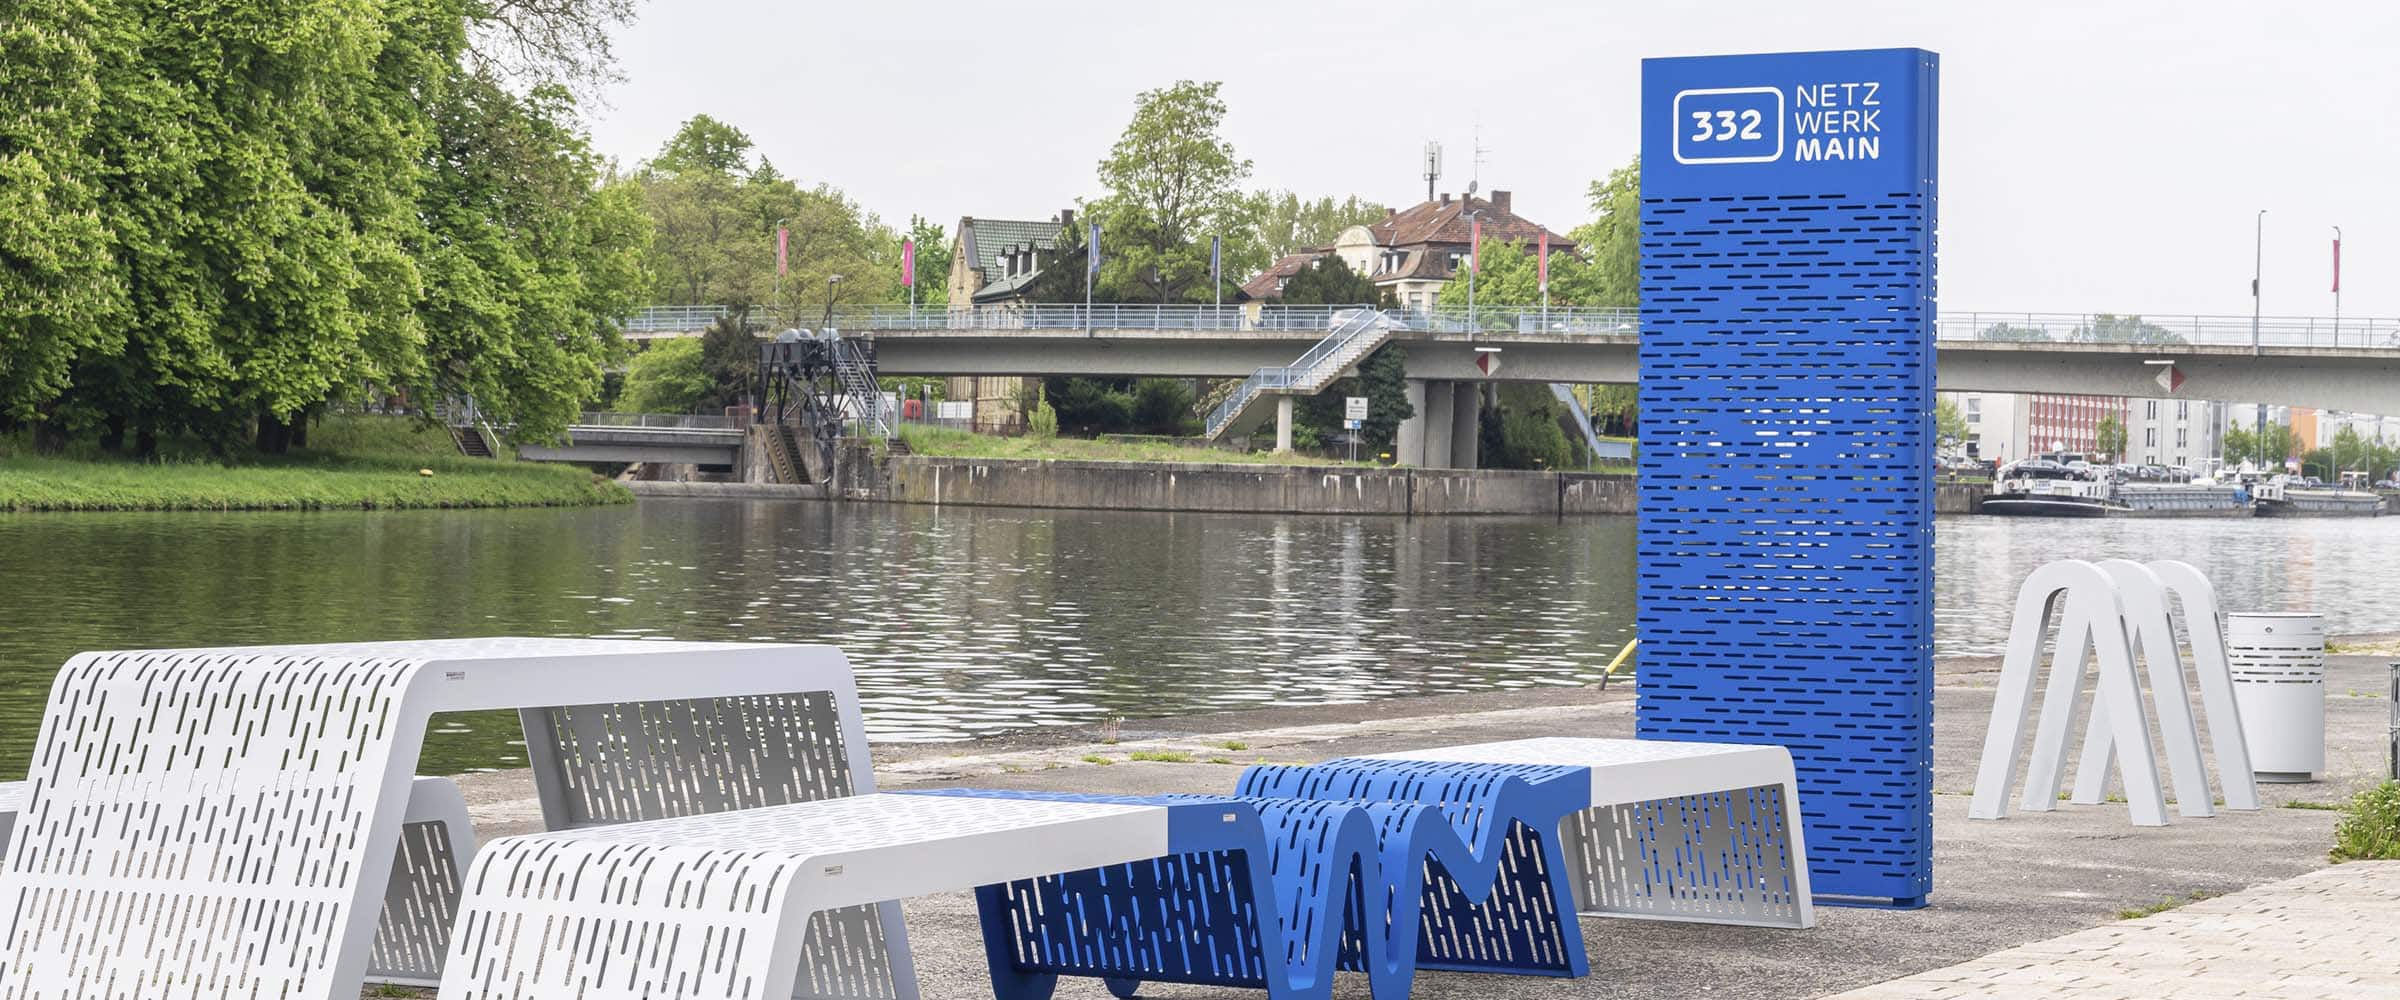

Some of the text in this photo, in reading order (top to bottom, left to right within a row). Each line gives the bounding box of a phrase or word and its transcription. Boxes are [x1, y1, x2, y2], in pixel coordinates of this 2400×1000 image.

[1796, 82, 1880, 107] NETZ
[1691, 109, 1762, 142] 332
[1795, 109, 1881, 134] WERK
[1795, 136, 1880, 161] MAIN
